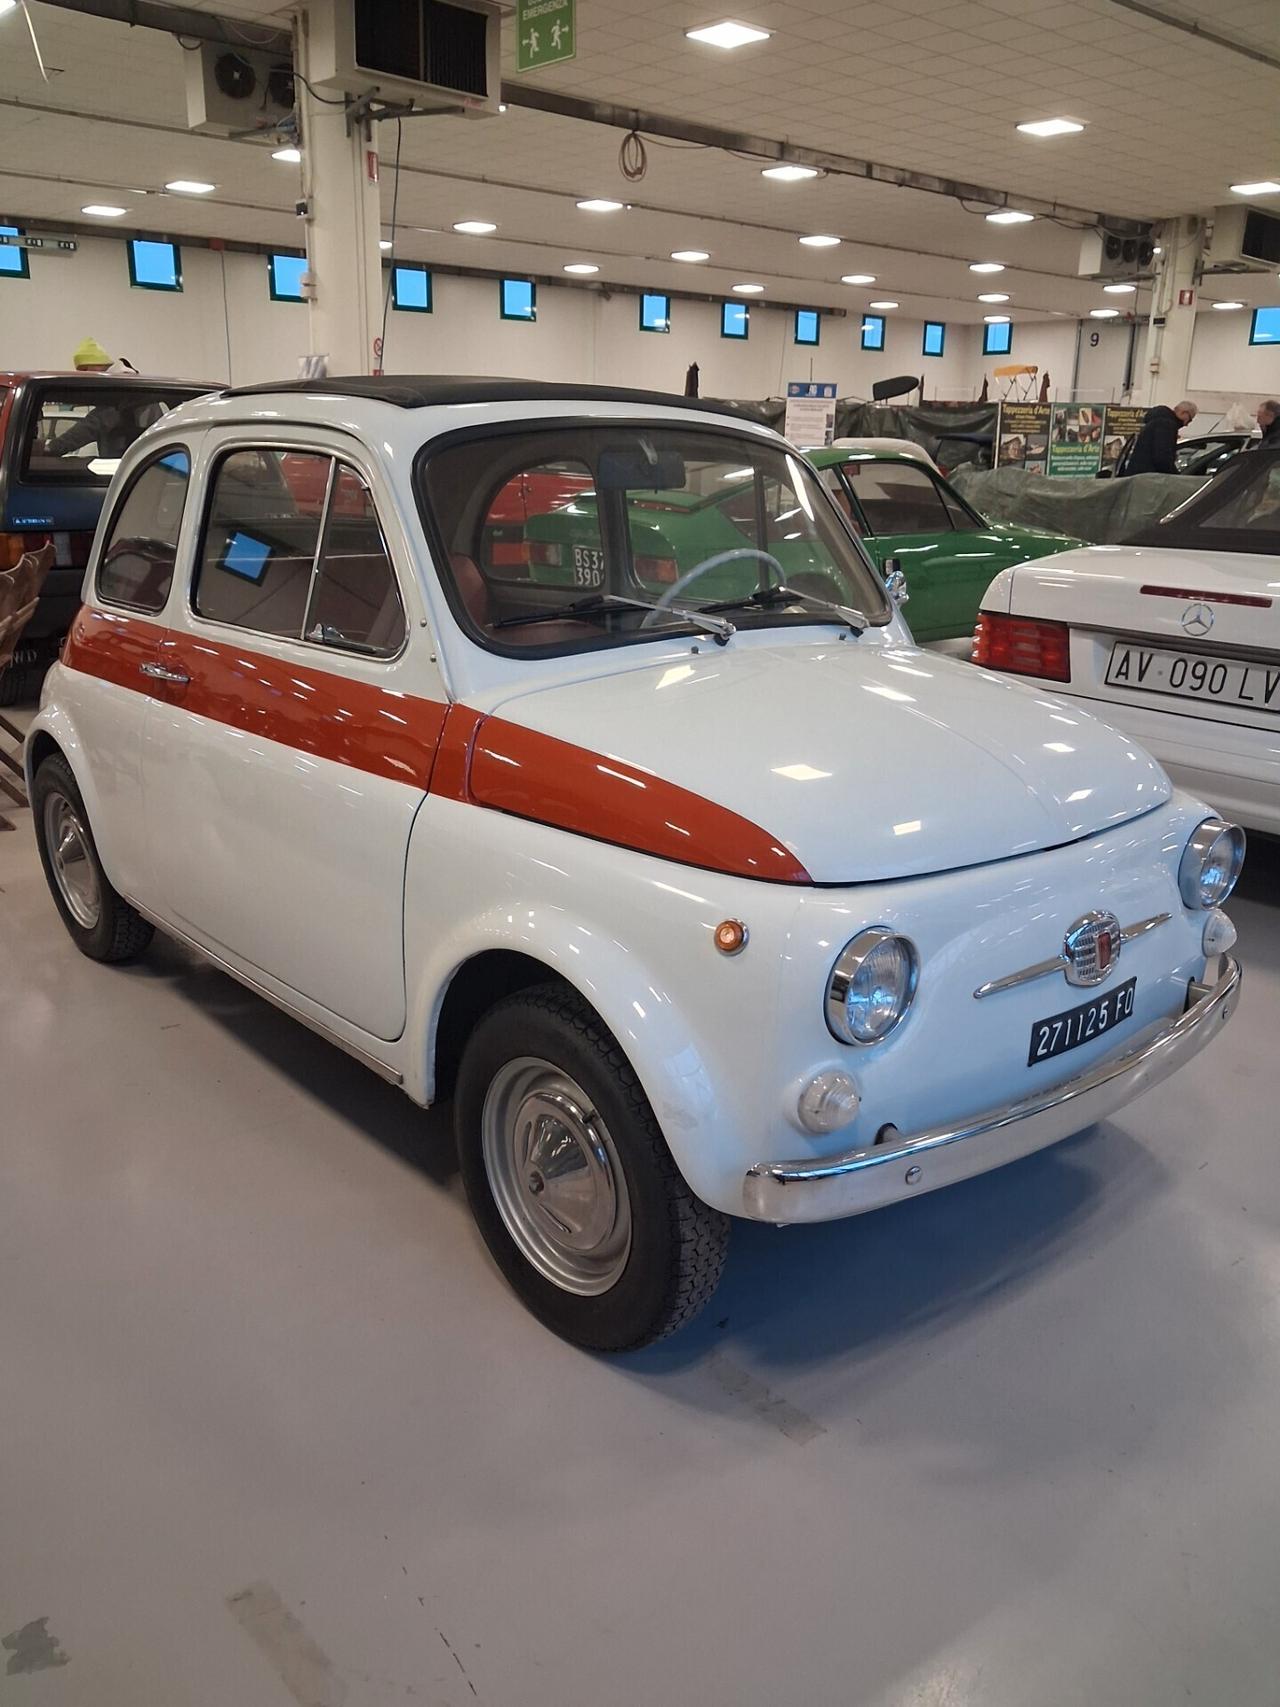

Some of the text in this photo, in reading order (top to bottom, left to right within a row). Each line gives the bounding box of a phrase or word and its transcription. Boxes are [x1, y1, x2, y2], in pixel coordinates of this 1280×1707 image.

[1090, 332, 1100, 347] 9
[1115, 650, 1280, 704] AV 090 LV
[1037, 1001, 1109, 1056] 271125
